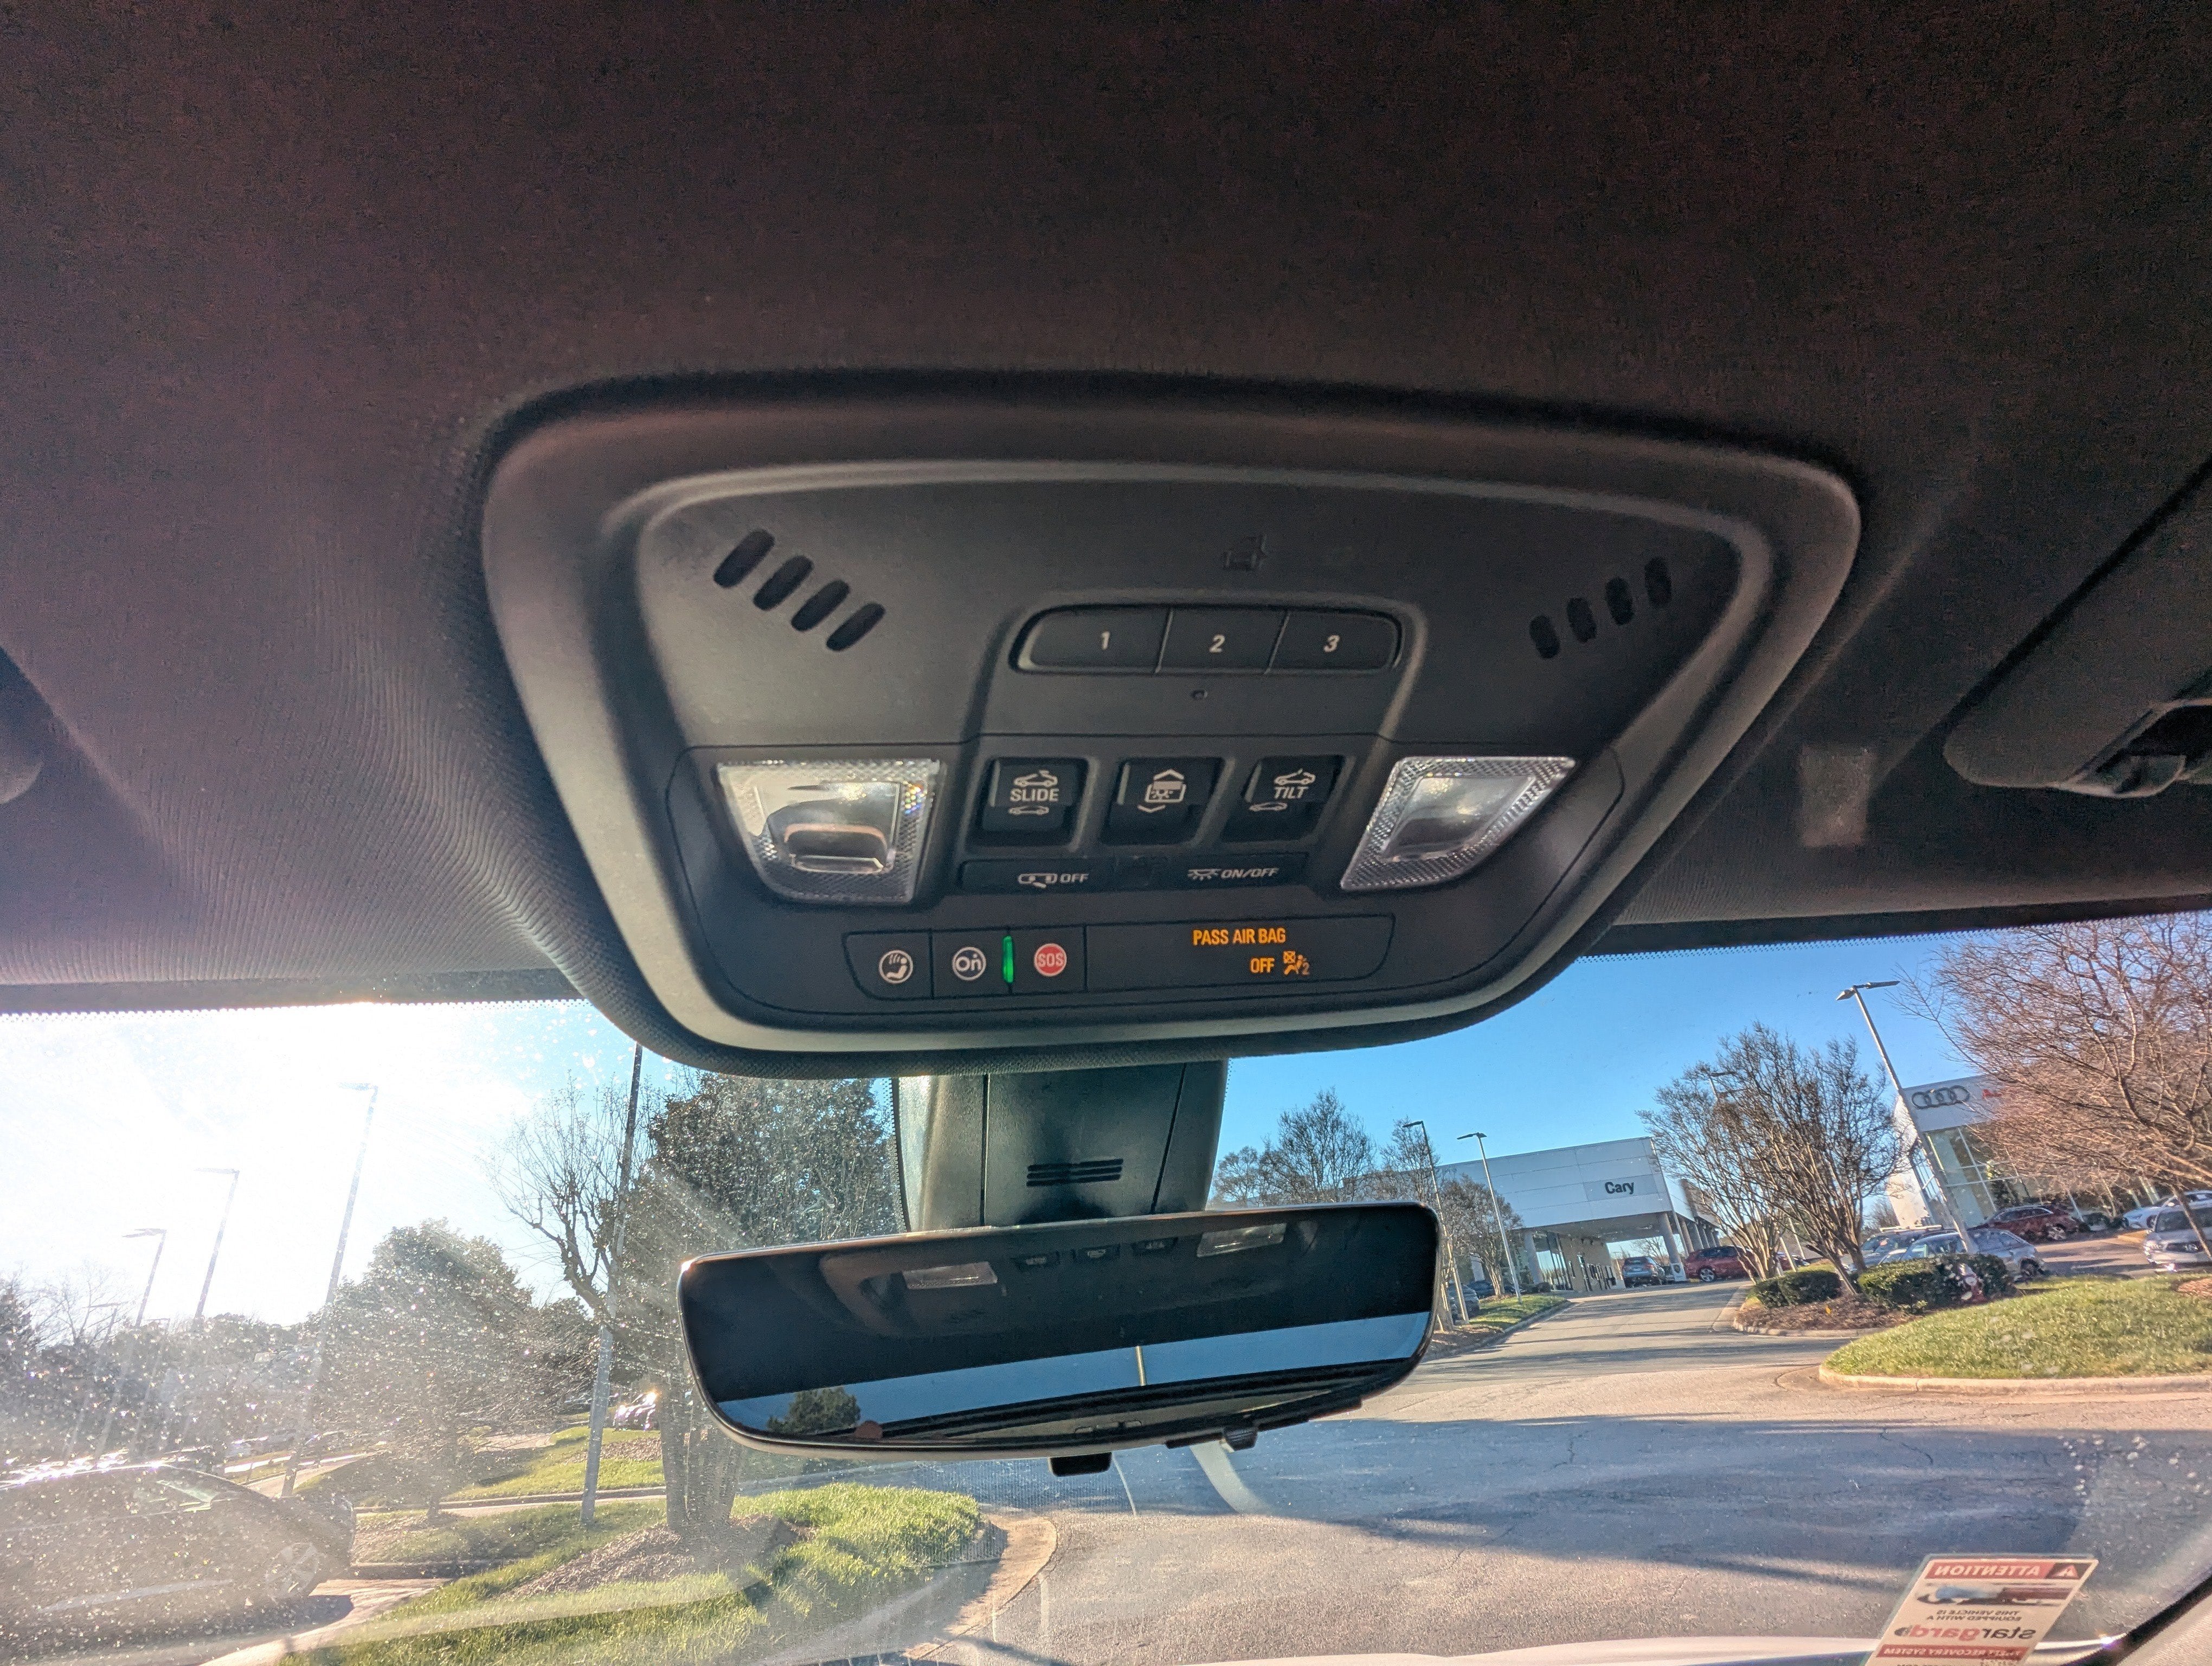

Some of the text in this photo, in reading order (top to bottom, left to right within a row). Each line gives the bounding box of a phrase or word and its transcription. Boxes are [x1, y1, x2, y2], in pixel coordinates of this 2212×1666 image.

[1101, 631, 1110, 650] 1
[1209, 635, 1225, 652] 2
[1323, 635, 1340, 652] 3
[1009, 788, 1059, 803] SLIDE
[1274, 787, 1306, 800] TILT
[1060, 874, 1089, 884] OFF
[1220, 868, 1279, 879] ON/OFF
[1193, 927, 1287, 946] PASS AIR BAG
[1037, 953, 1064, 967] SOS
[1250, 957, 1275, 974] OFF
[1605, 1181, 1635, 1195] Cary
